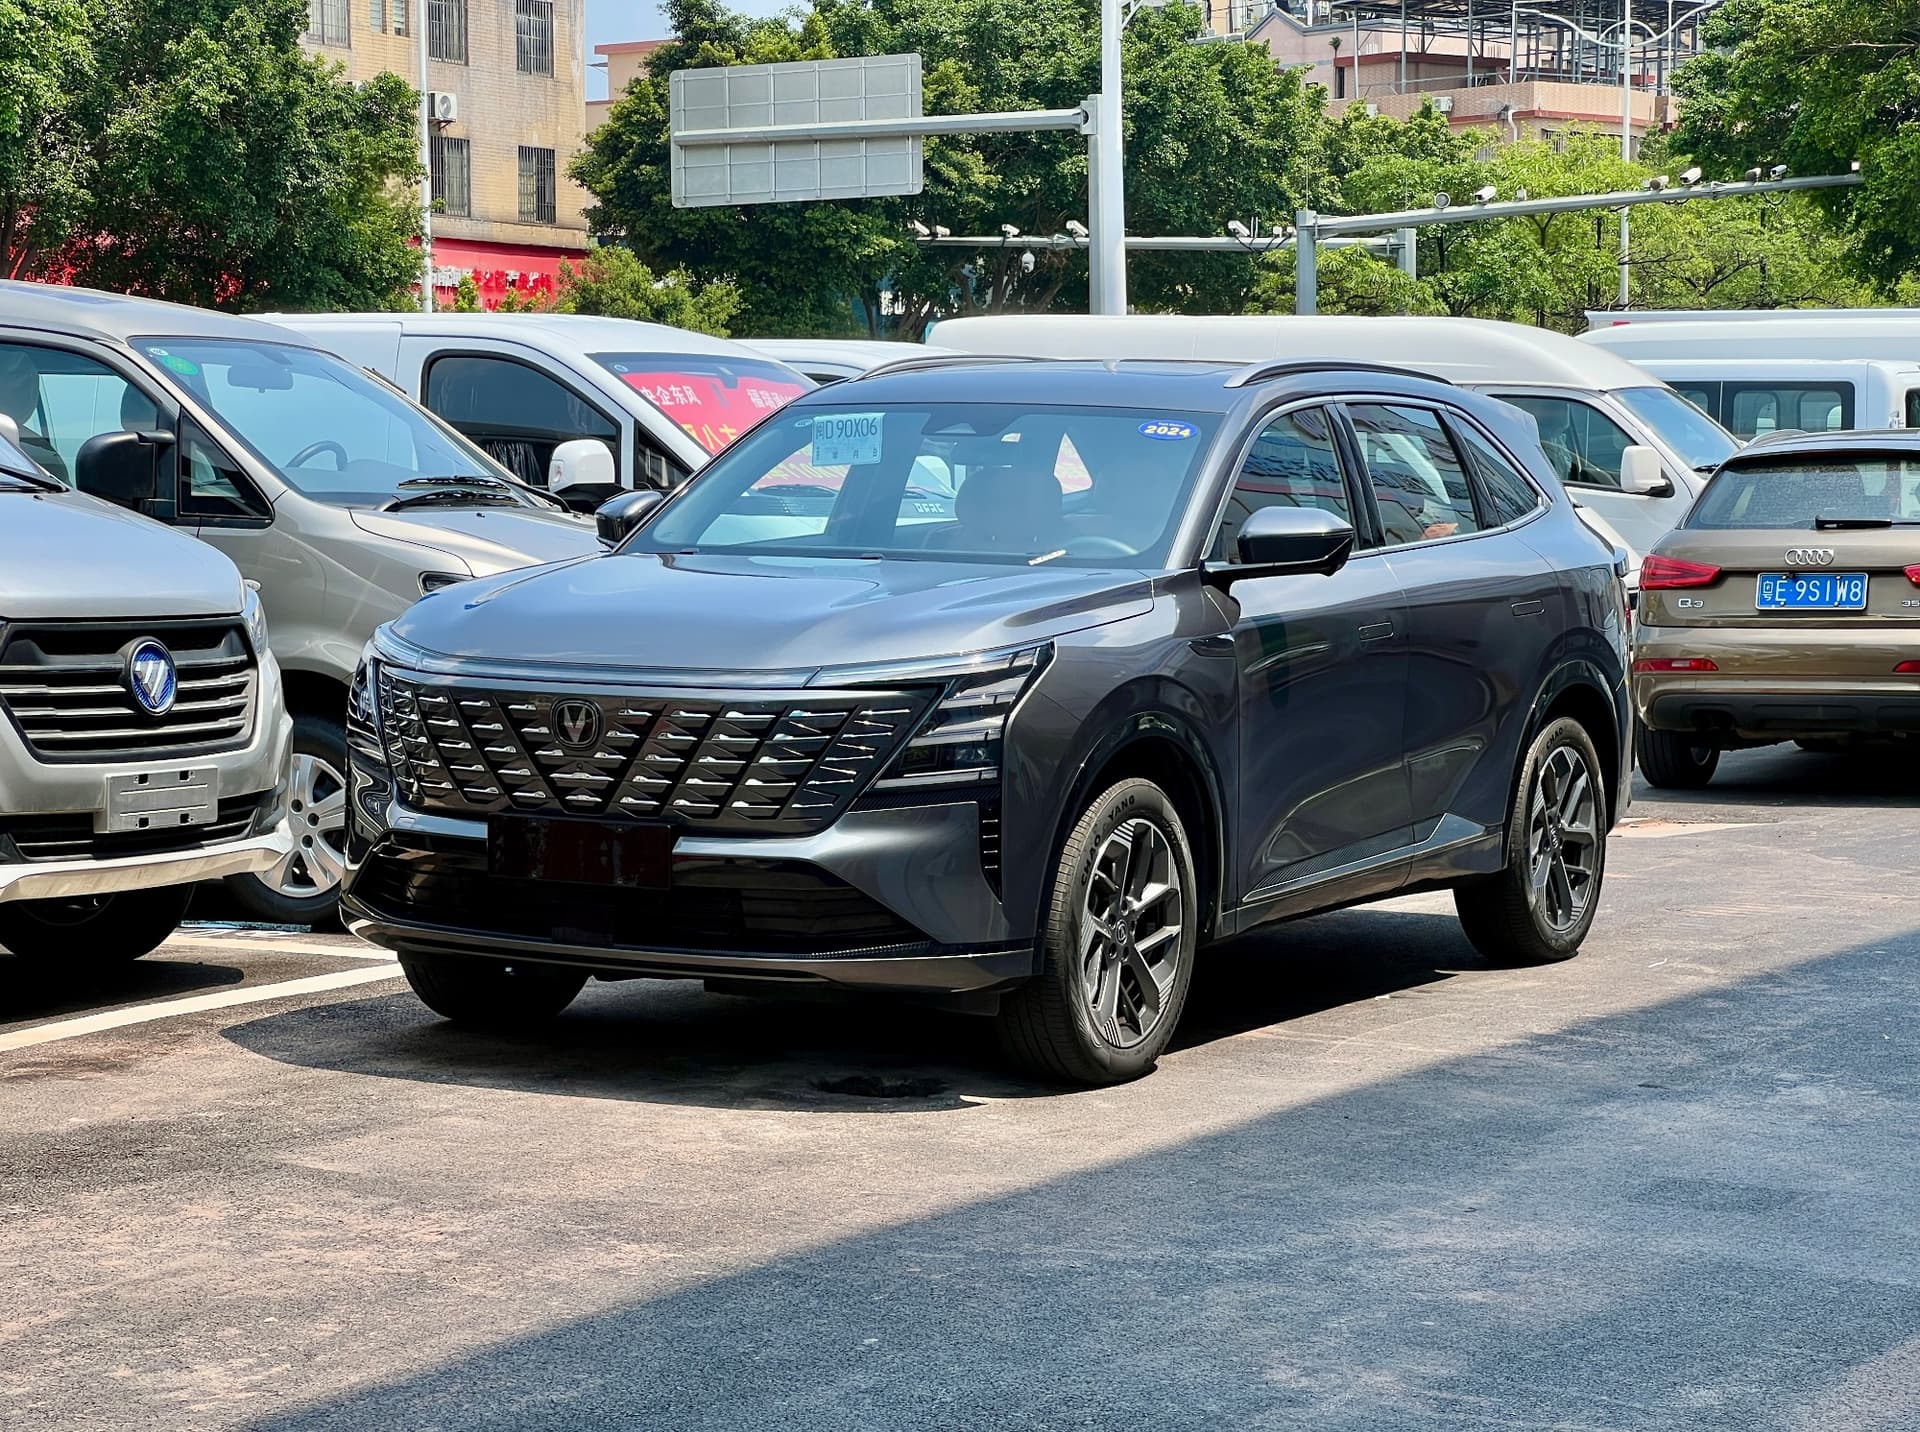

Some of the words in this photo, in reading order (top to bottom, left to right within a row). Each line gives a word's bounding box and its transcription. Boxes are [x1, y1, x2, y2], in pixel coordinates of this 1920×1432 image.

[1144, 425, 1190, 437] 2024
[1678, 598, 1704, 608] Q3
[1081, 834, 1101, 886] CHAO
[1108, 795, 1136, 820] YANG
